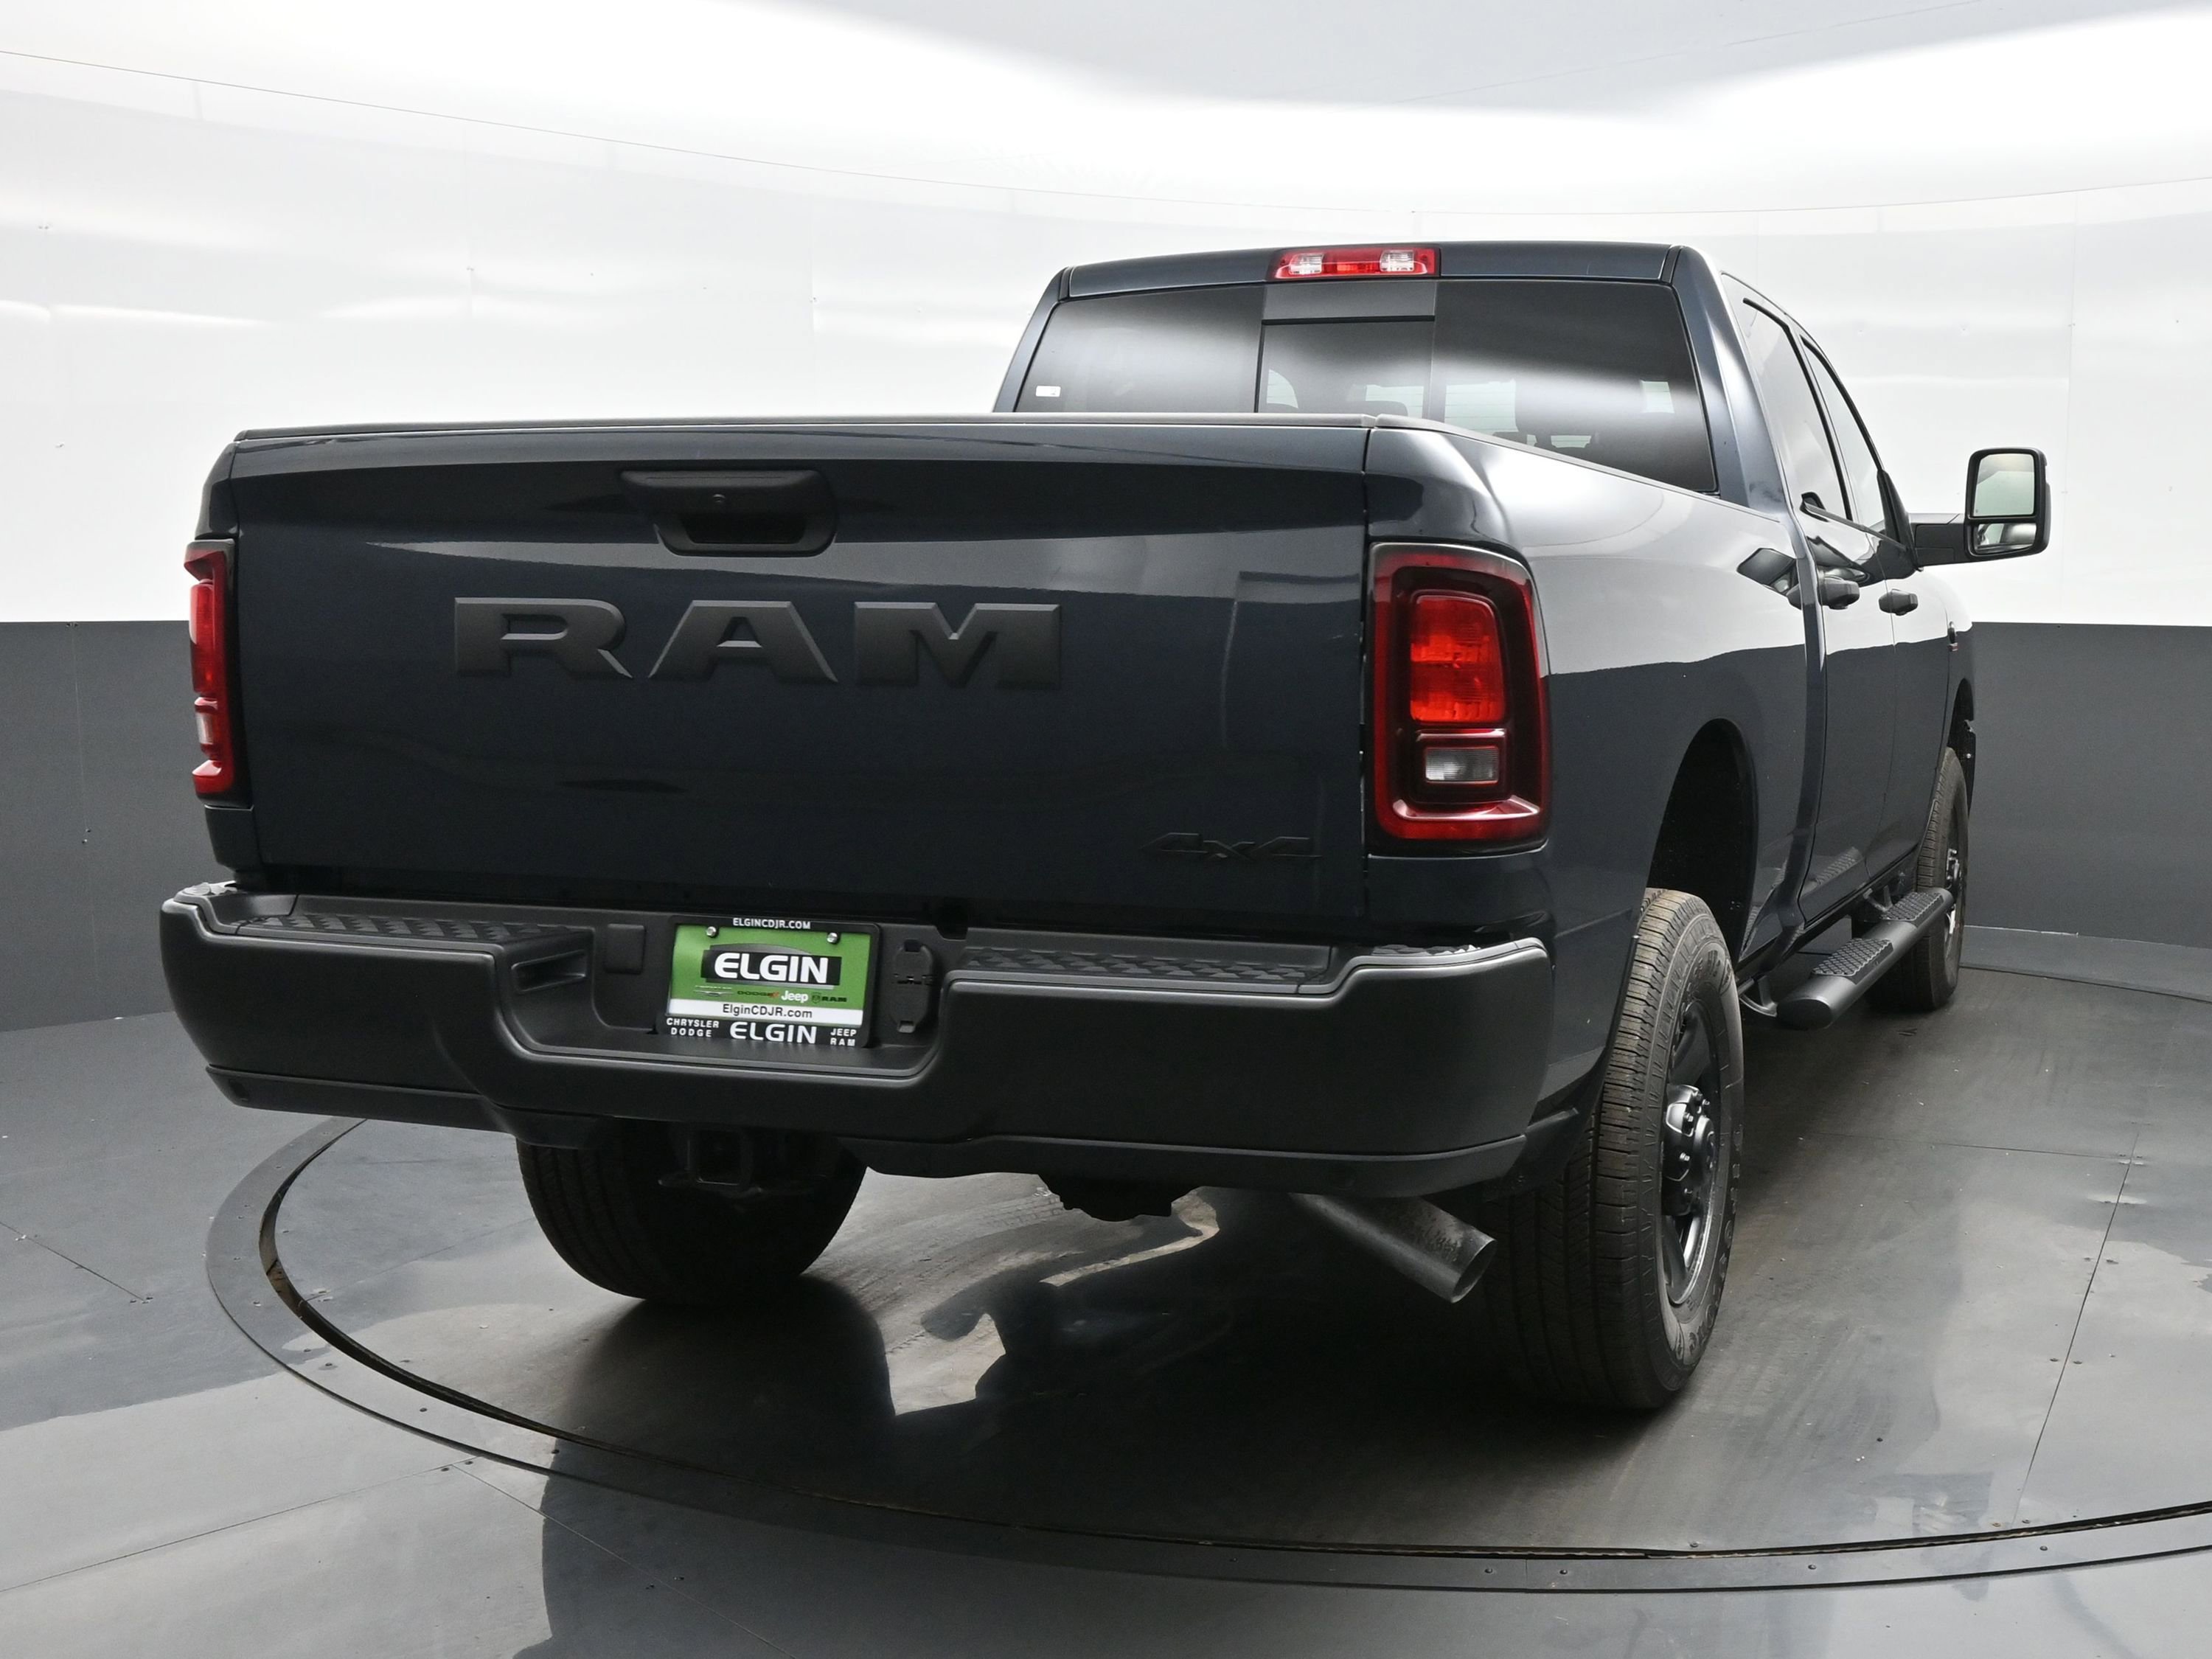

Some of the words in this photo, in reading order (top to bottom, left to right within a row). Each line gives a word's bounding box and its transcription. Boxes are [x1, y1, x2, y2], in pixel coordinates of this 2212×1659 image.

[453, 597, 1062, 689] RAM
[733, 918, 811, 930] ELGINCDJR.COM
[714, 952, 829, 984] ELGIN
[781, 990, 809, 1004] Jeep
[723, 1004, 813, 1018] ElginCDJR.com
[667, 1018, 720, 1029] CHRYSLER
[670, 1027, 712, 1037] DODGE
[729, 1021, 818, 1044] ELGIN
[830, 1028, 857, 1037] JEEP
[830, 1037, 856, 1046] RAM
